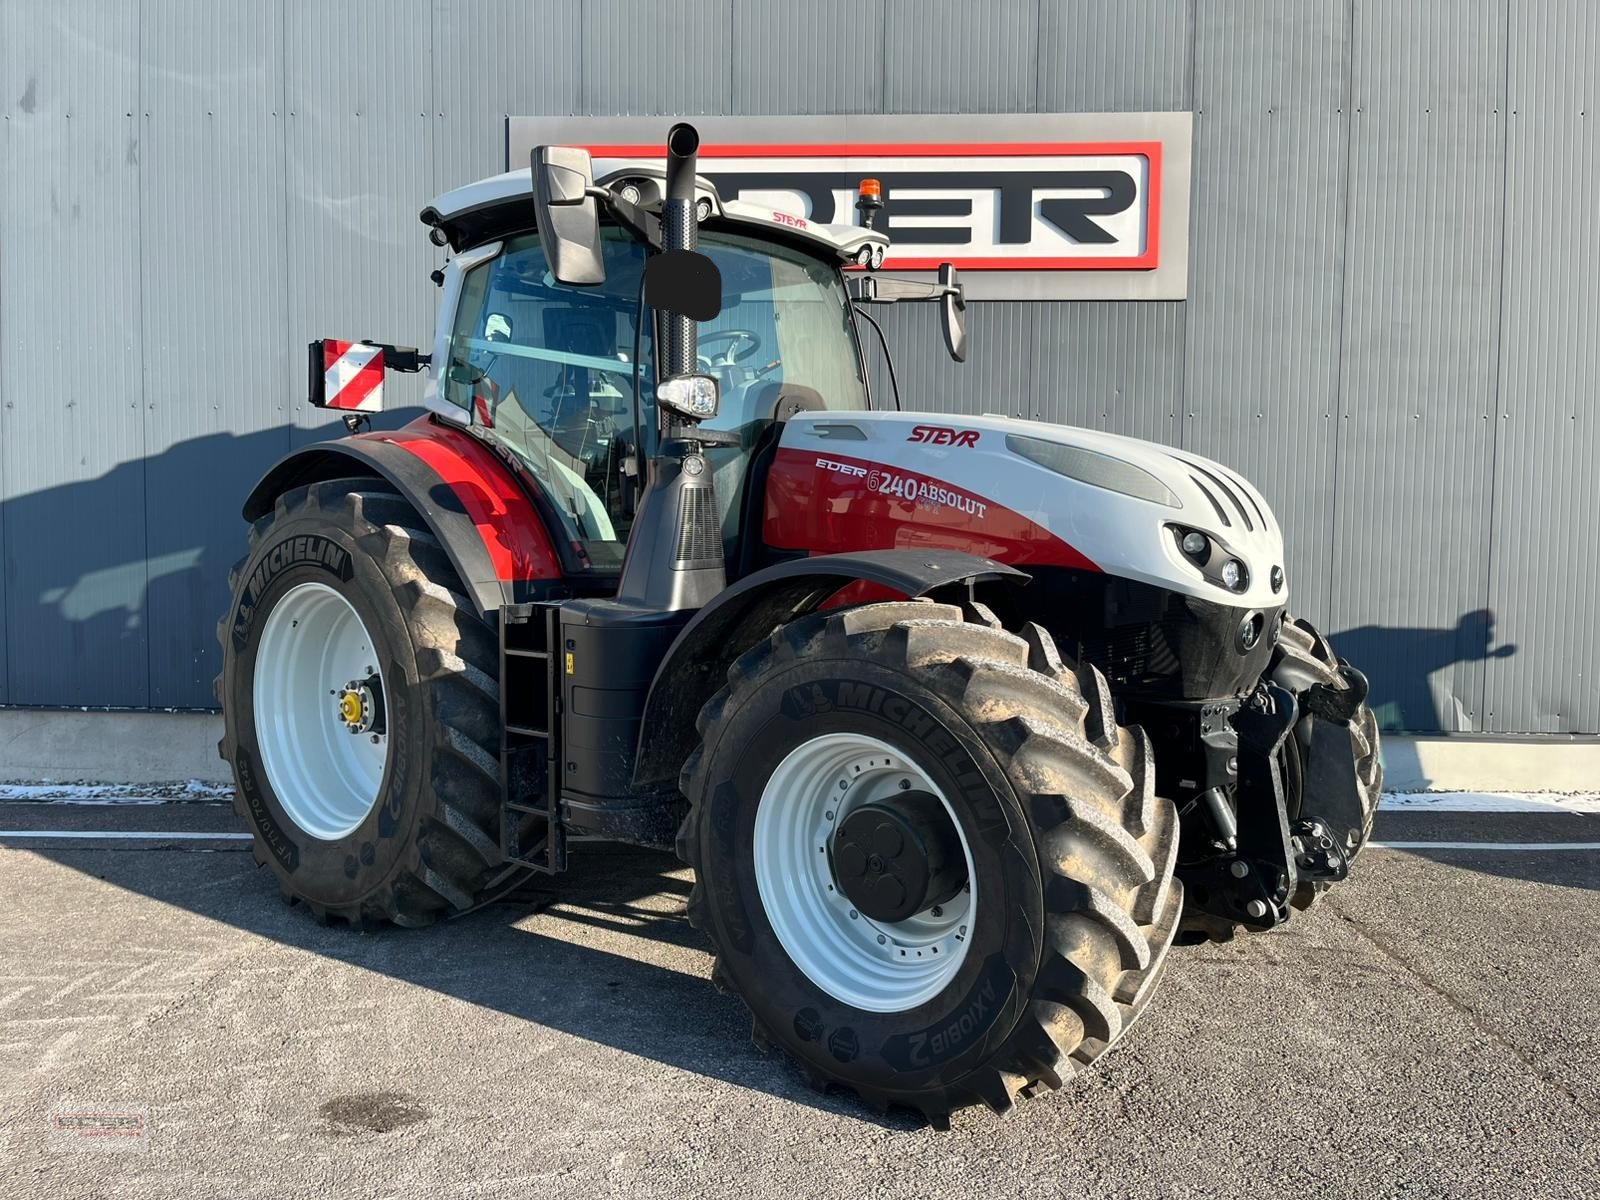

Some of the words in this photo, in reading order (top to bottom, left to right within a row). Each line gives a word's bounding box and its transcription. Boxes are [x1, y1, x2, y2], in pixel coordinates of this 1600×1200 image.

[772, 211, 807, 230] STEYR
[906, 425, 981, 448] STEYR
[816, 458, 867, 478] EDER
[867, 470, 917, 500] 6240
[918, 482, 986, 518] ABSOLUT
[248, 536, 344, 600] MICHELIN
[838, 681, 1007, 829] MICHELIN
[251, 798, 282, 847] 710/70
[276, 846, 293, 865] VF
[930, 975, 996, 1055] AXIOBIB
[908, 1031, 931, 1069] 2
